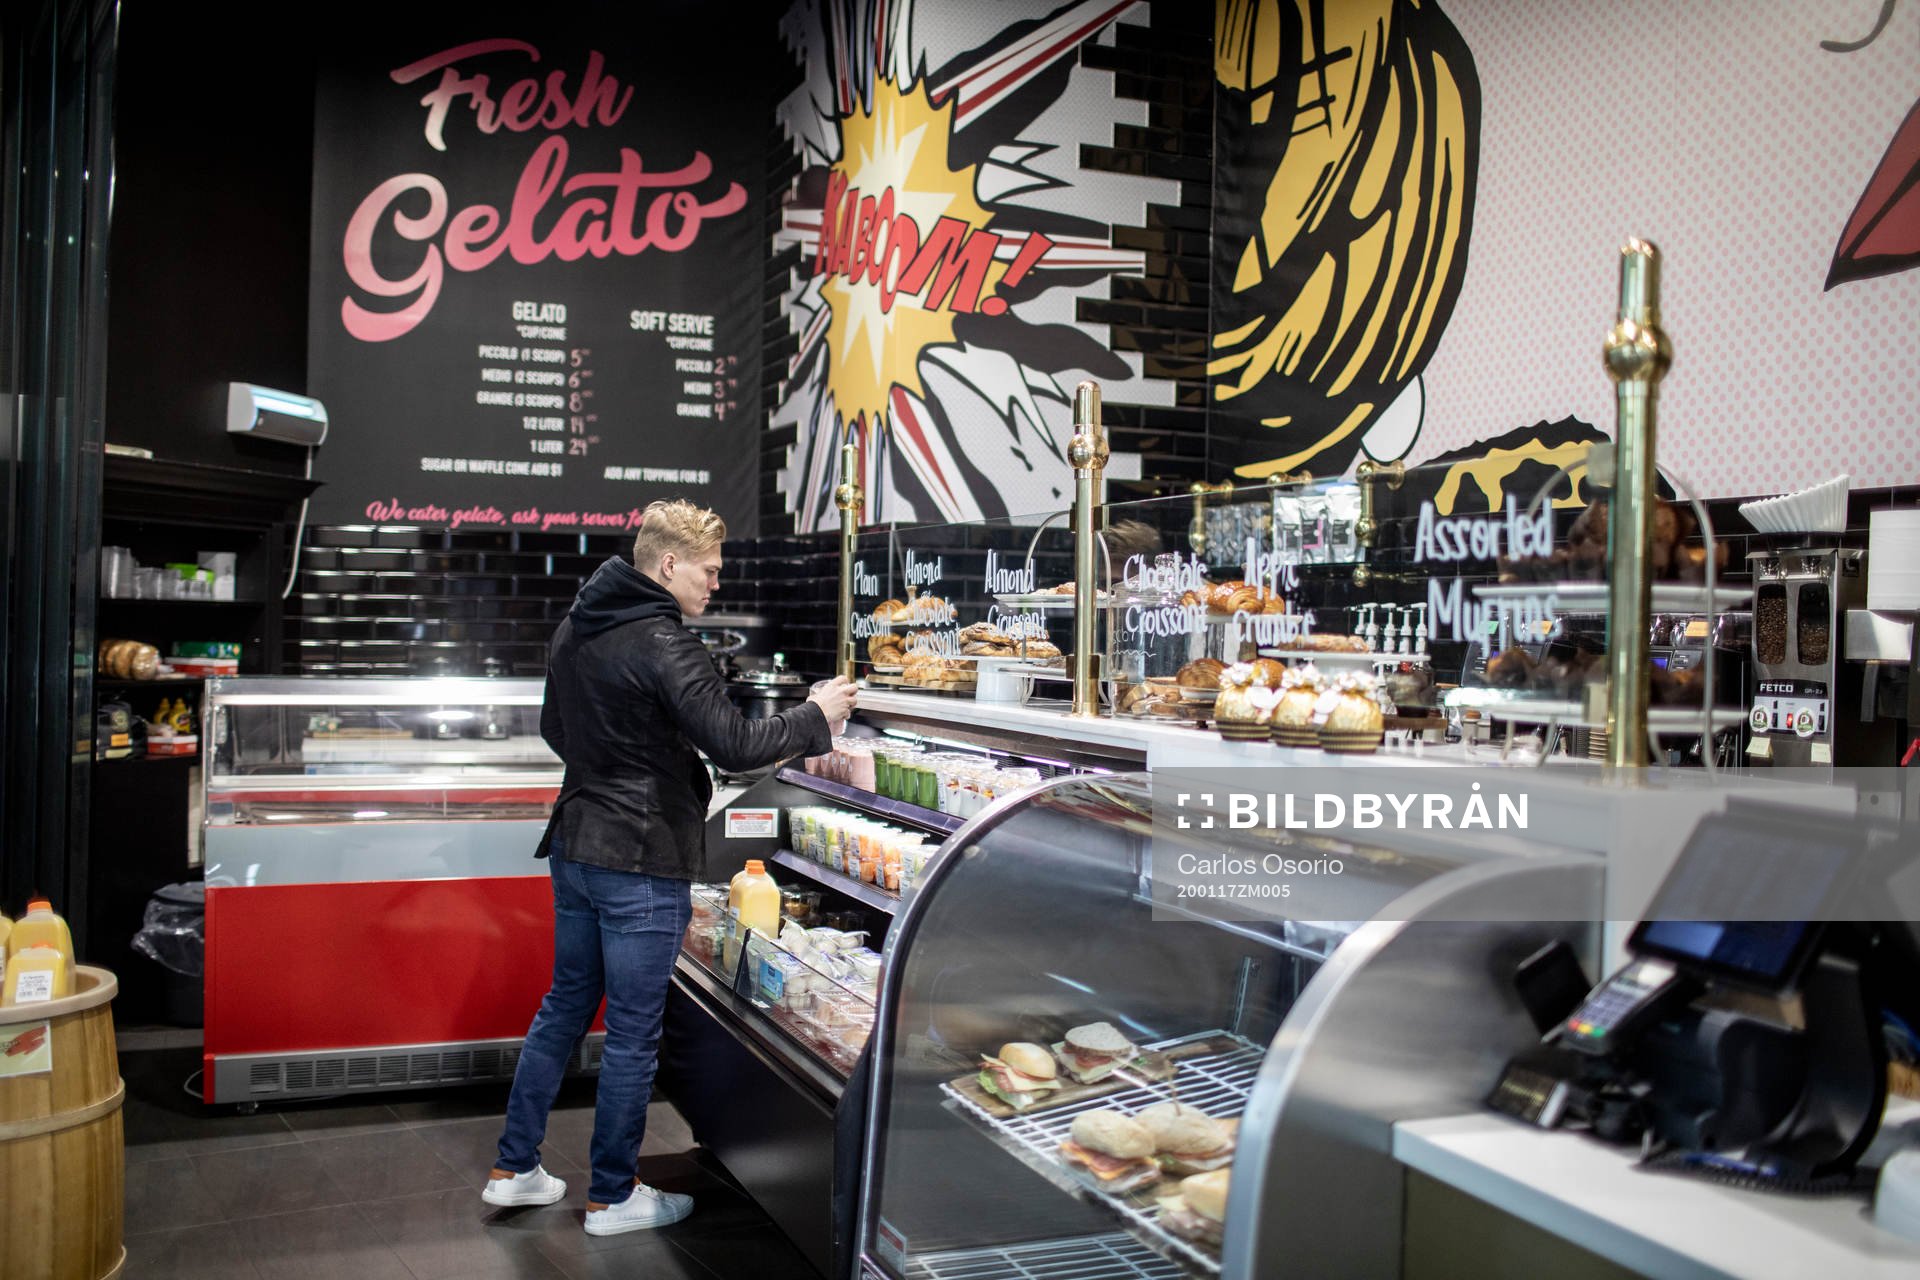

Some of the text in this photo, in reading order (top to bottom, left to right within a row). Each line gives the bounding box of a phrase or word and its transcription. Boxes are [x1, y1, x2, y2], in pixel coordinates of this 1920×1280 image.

[389, 38, 634, 151] Fresh
[341, 135, 748, 342] Gelato
[512, 301, 567, 323] GELATO
[630, 310, 714, 335] SOFT SERVE
[478, 344, 518, 360] PICCOLO
[675, 358, 712, 373] PICCOLO
[538, 417, 564, 431] LITER
[538, 440, 563, 454] LITER
[421, 457, 452, 472] SUGAR
[468, 460, 505, 475] WAFFLE
[365, 497, 405, 522] We
[511, 507, 540, 525] ask
[541, 510, 580, 531] your
[1414, 493, 1555, 562] Assorted
[853, 560, 879, 597] Plain
[905, 548, 942, 588] Almond
[984, 549, 1036, 594] Almond
[1123, 551, 1208, 594] Chocolate
[1125, 600, 1209, 637] Croissant
[1760, 683, 1794, 693] FETCO
